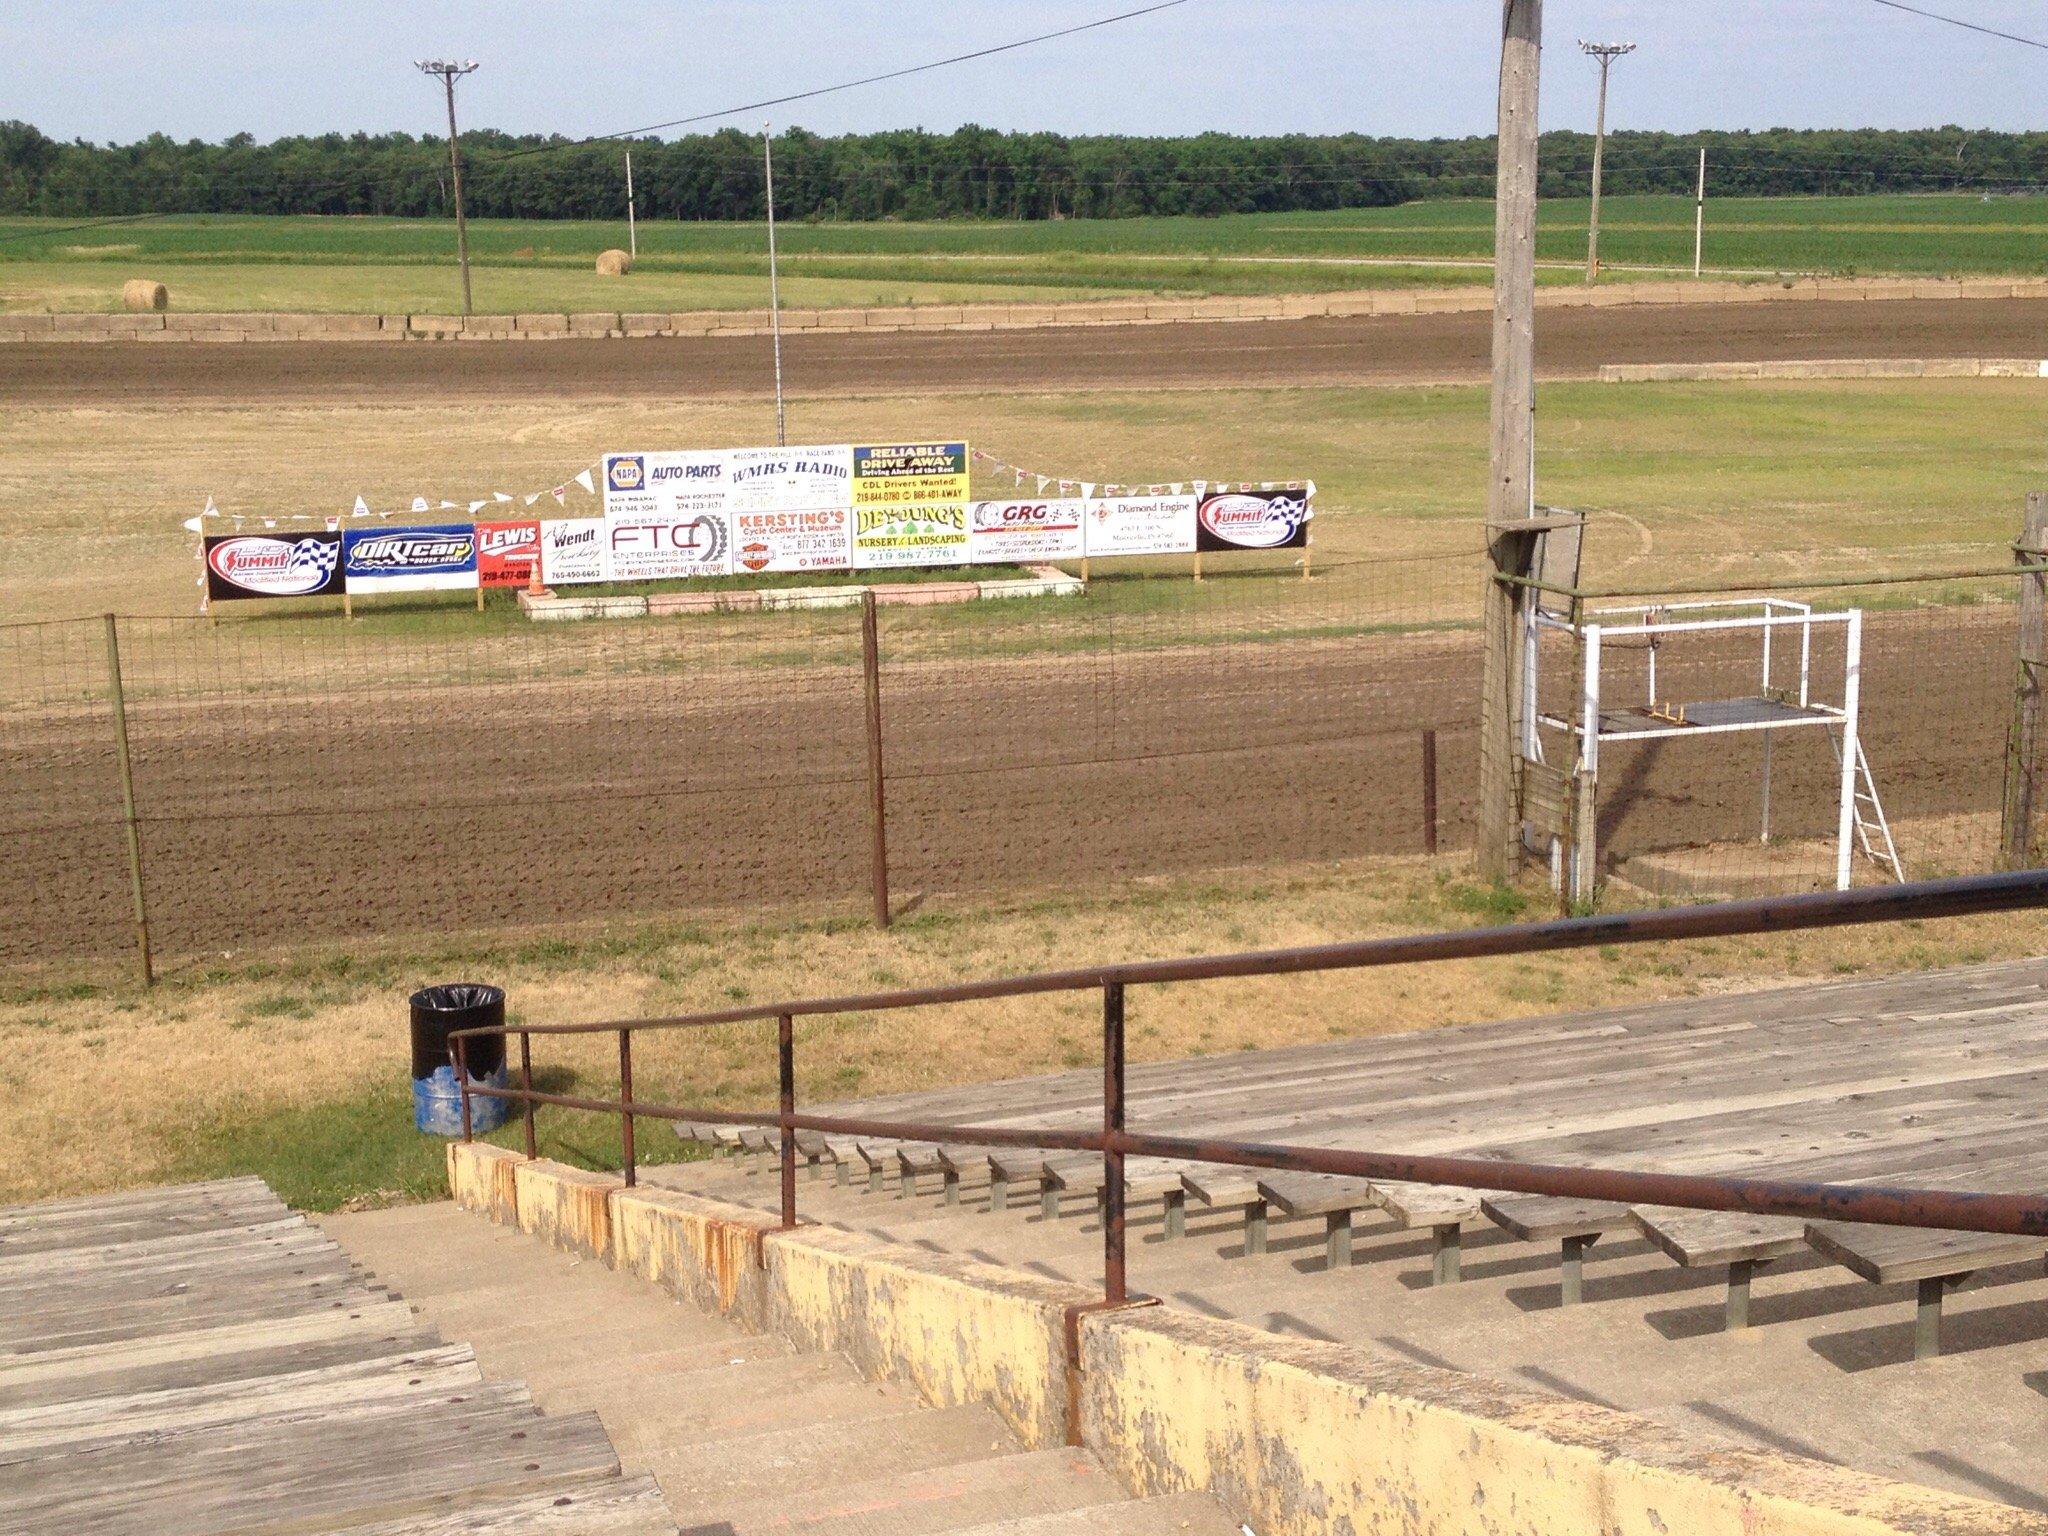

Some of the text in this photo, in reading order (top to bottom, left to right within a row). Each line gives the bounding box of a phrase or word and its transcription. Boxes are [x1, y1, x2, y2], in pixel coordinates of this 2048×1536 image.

[871, 446, 946, 459] RELIABLE
[861, 456, 955, 469] DRIVE AWAY
[616, 468, 637, 479] NAPA
[652, 464, 721, 480] AUTO PARTS
[733, 461, 847, 484] WMRS RADIO
[891, 467, 913, 475] Ahead
[862, 478, 957, 489] CDL Drivers Wanted!
[1003, 505, 1047, 521] GRG
[1118, 501, 1190, 514] Diamond Engine
[739, 510, 844, 527] KERSTING'S
[612, 523, 701, 551] FTC
[743, 527, 767, 536] Cycle
[769, 526, 796, 534] Center
[480, 527, 536, 552] LEWIS
[554, 529, 595, 548] Wendt
[797, 539, 809, 549] 877
[813, 539, 826, 549] 342
[829, 538, 846, 548] 1639
[858, 538, 897, 547] NURSERY
[908, 534, 966, 545] LANDSCAPING
[613, 550, 694, 559] ENTERPRISES
[811, 555, 847, 567] YAMAHA
[614, 564, 724, 577] THE WHEELS THAT DRIVE THE FUTURE
